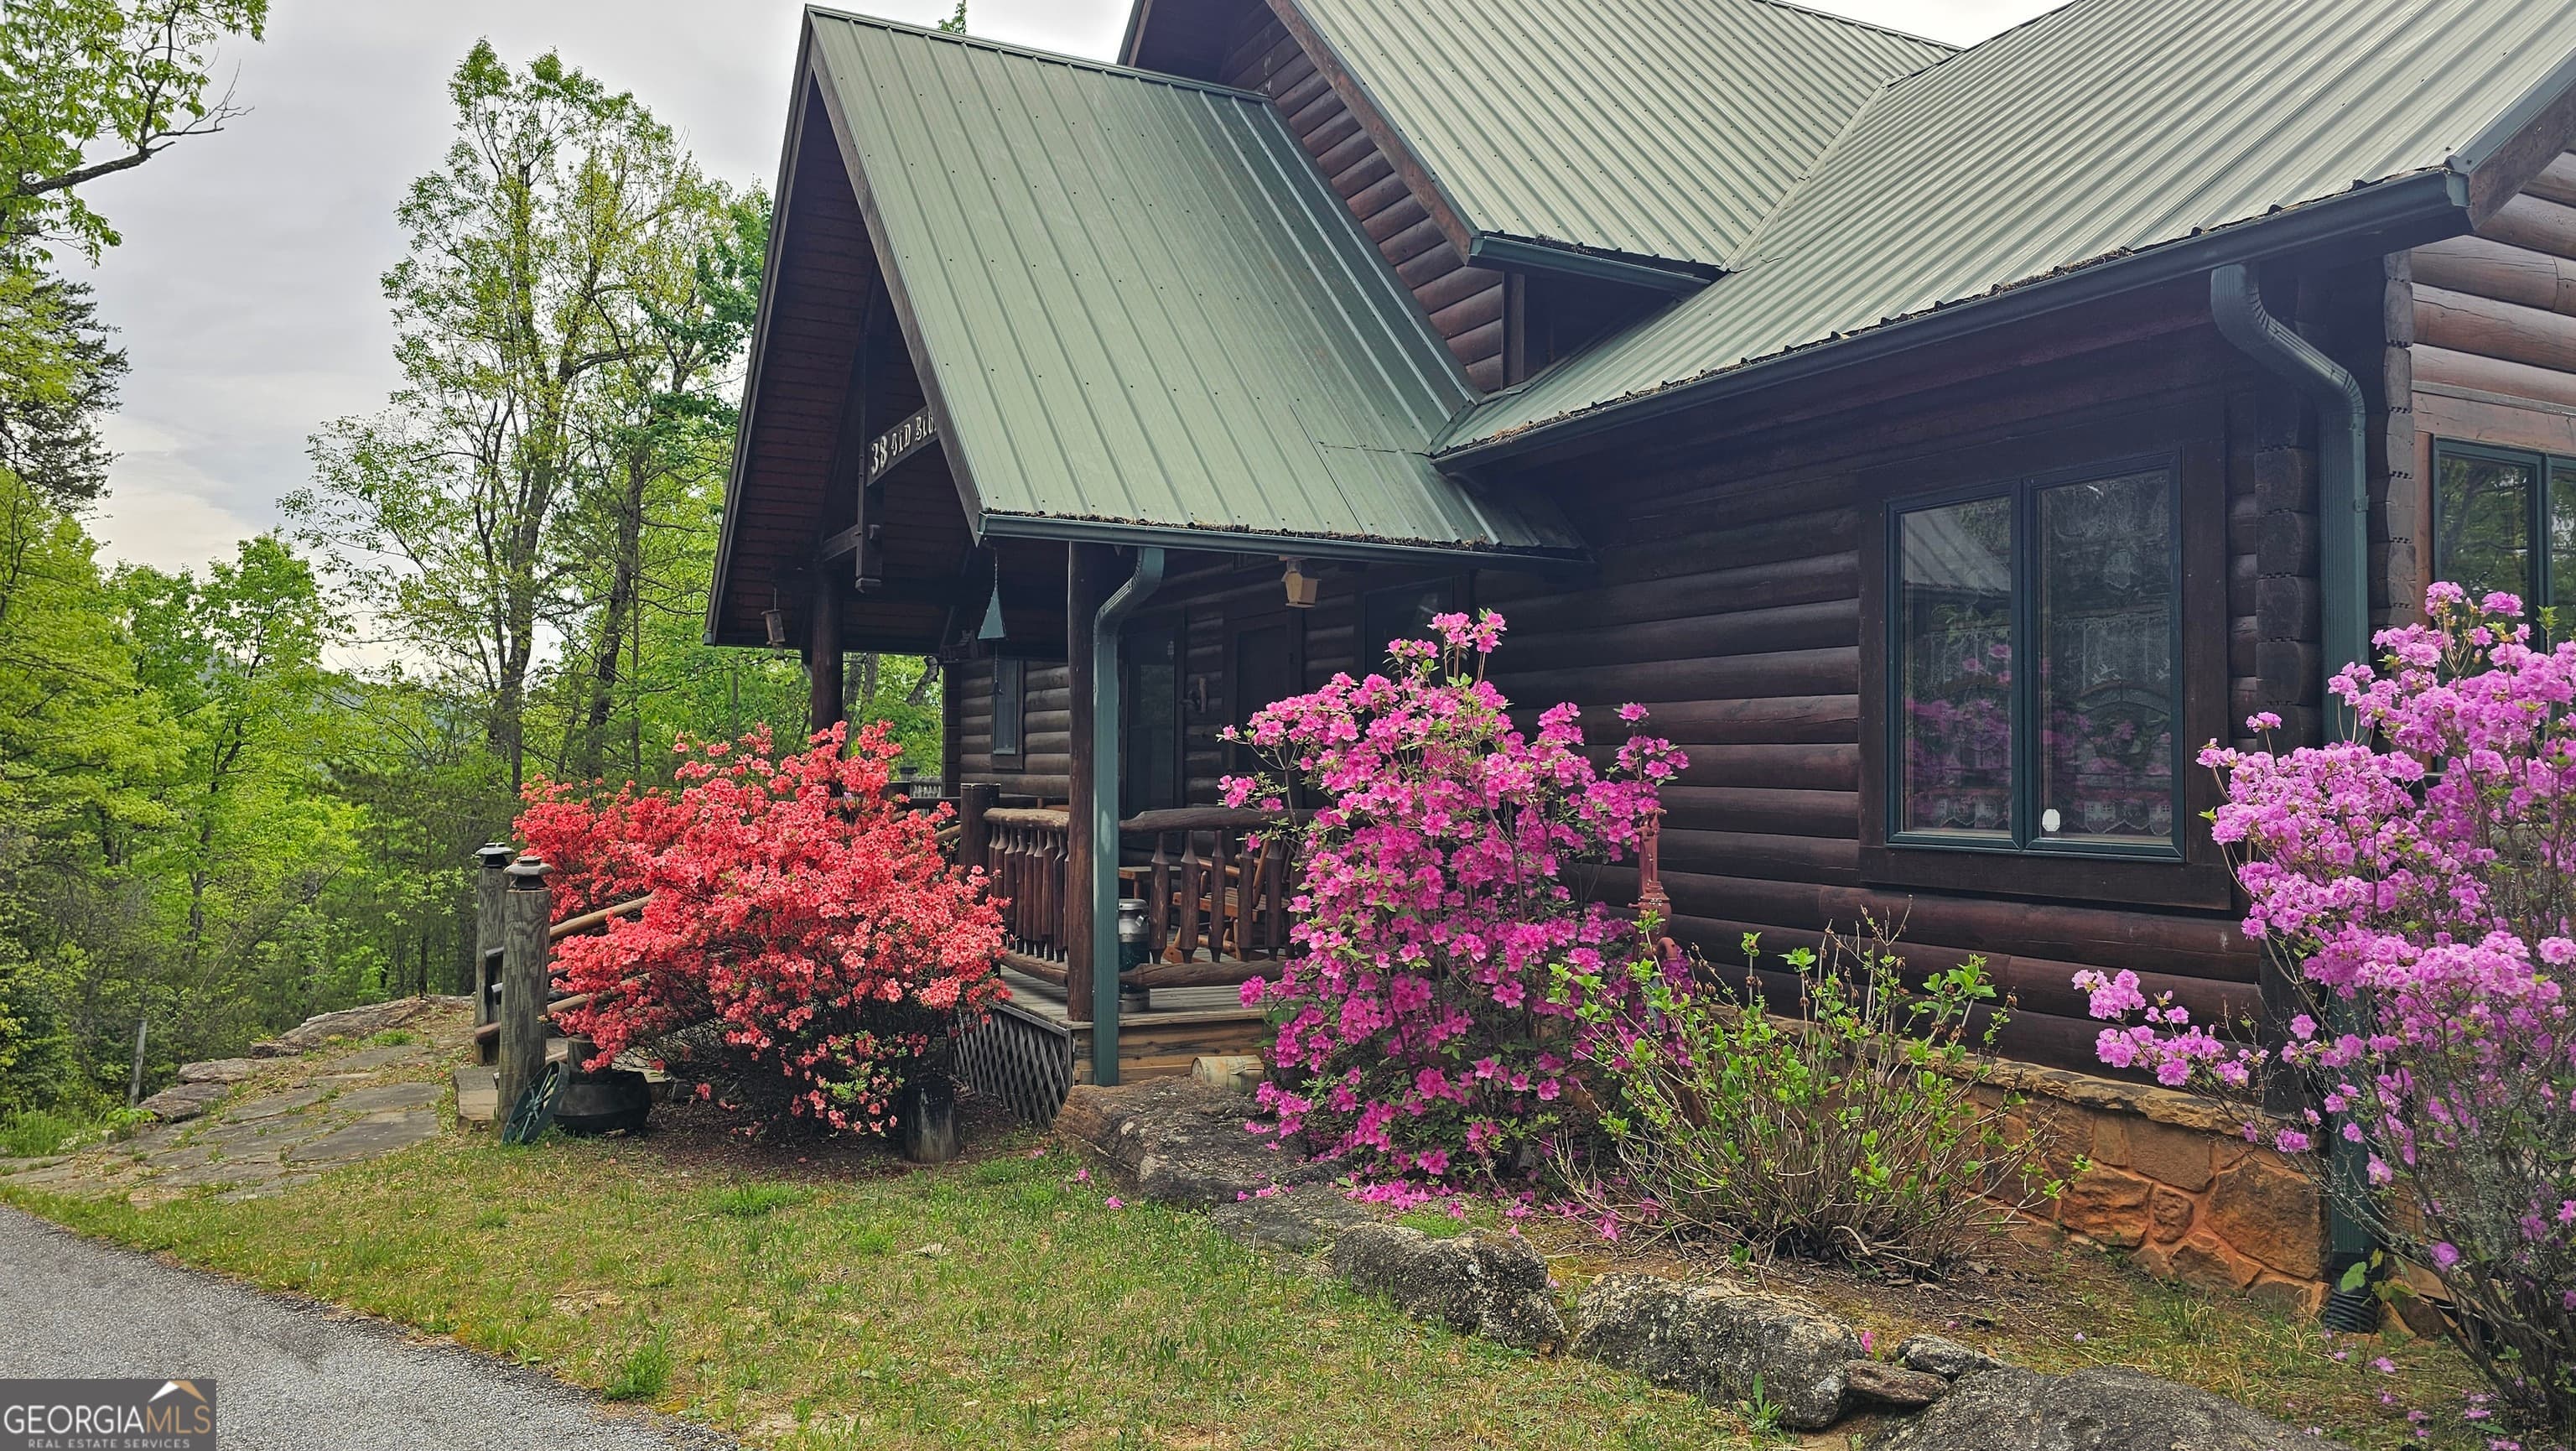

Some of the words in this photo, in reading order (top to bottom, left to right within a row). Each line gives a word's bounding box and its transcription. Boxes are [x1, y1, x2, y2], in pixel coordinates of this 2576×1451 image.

[870, 435, 888, 475] 38
[891, 423, 911, 456] OLD
[914, 410, 937, 441] BLU
